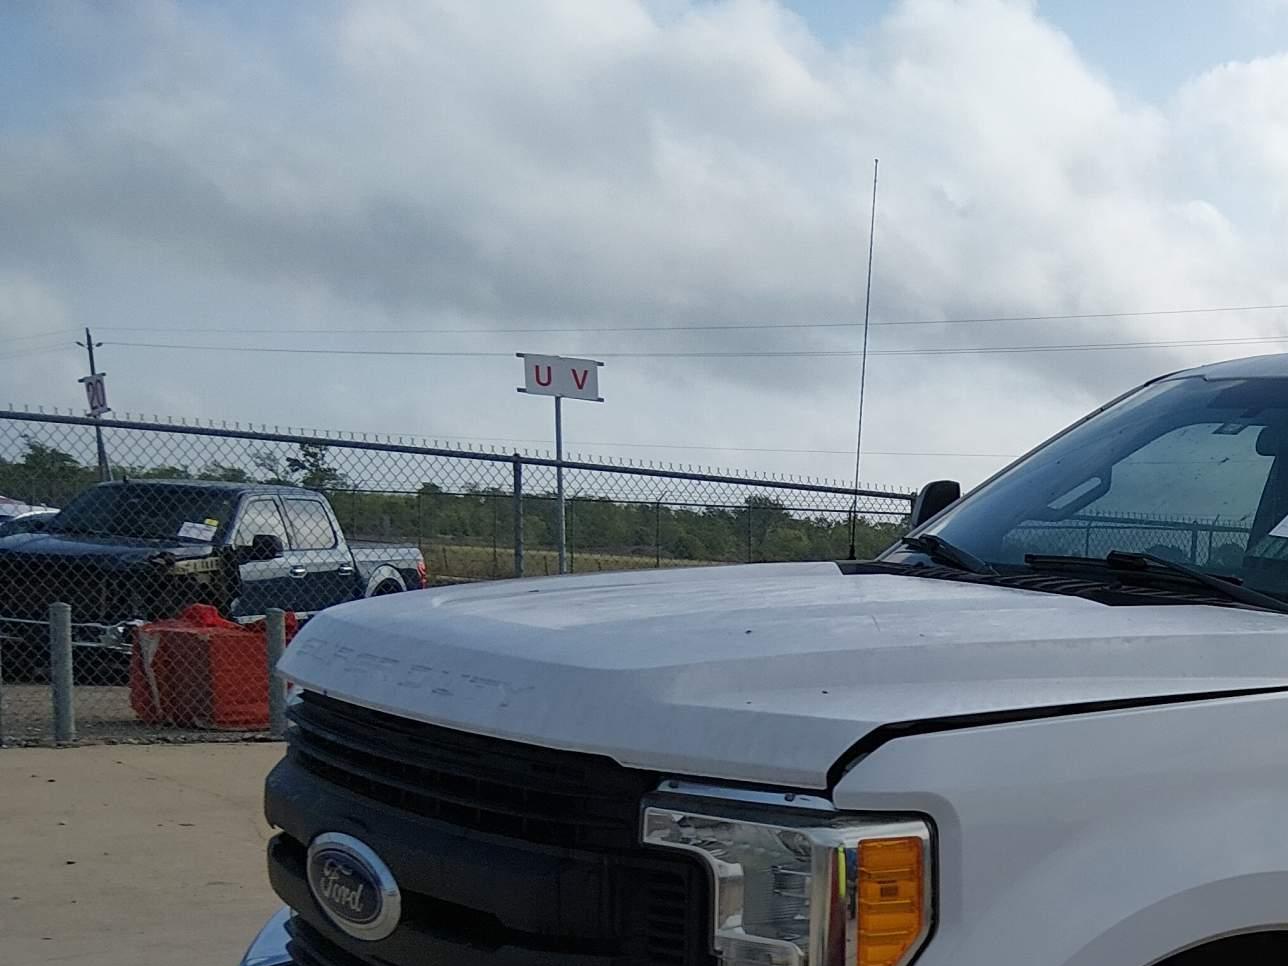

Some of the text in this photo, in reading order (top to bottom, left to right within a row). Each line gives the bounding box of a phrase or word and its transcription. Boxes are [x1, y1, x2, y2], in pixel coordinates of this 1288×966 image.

[535, 365, 588, 390] U V
[87, 379, 107, 410] 20
[321, 859, 365, 913] Ford
